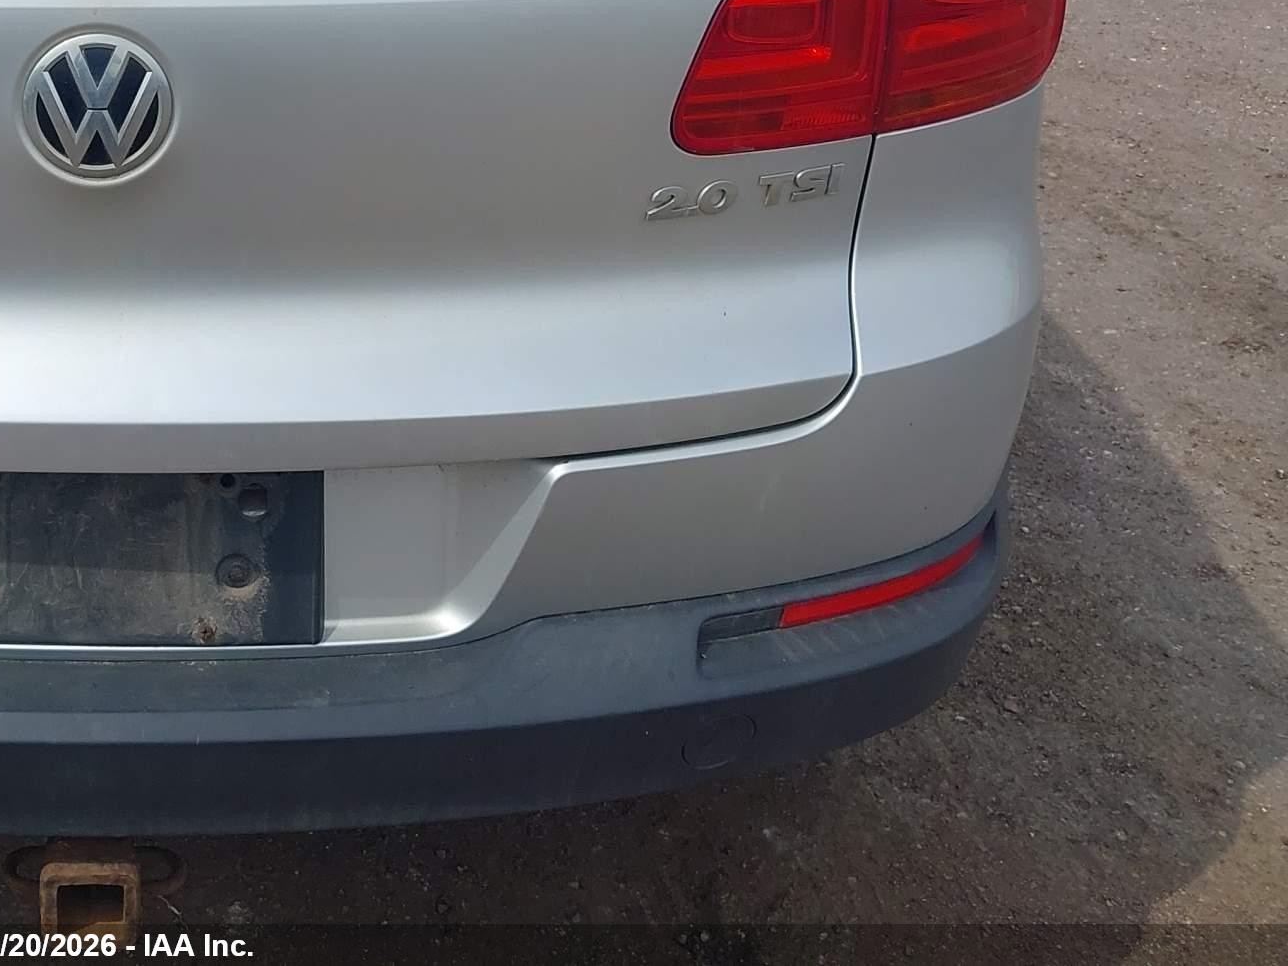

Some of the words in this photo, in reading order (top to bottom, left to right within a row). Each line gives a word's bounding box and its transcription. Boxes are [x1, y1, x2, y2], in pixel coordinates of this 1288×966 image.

[26, 35, 171, 176] VW
[644, 180, 738, 221] 2.0
[758, 162, 846, 207] TSI
